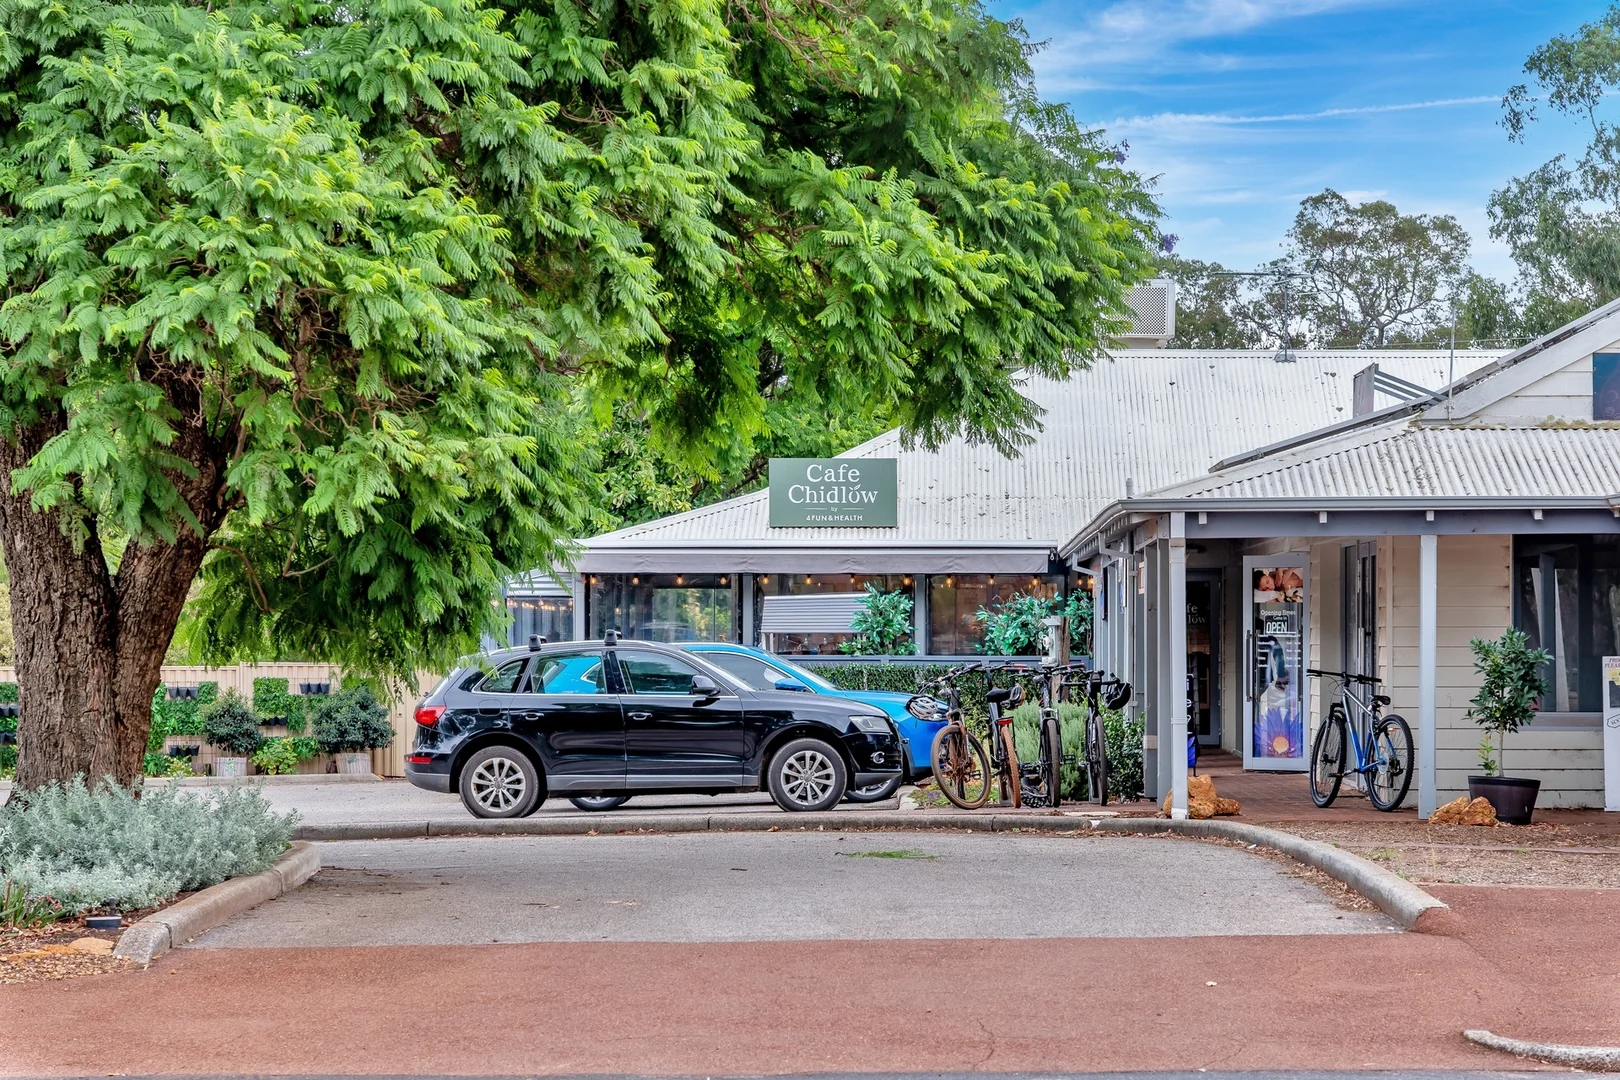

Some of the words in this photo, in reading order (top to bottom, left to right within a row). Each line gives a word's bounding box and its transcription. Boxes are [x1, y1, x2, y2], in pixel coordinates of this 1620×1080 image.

[806, 463, 860, 482] Cafe
[788, 484, 878, 504] Chidlow
[1187, 603, 1198, 613] fe
[1266, 621, 1288, 633] OPEN
